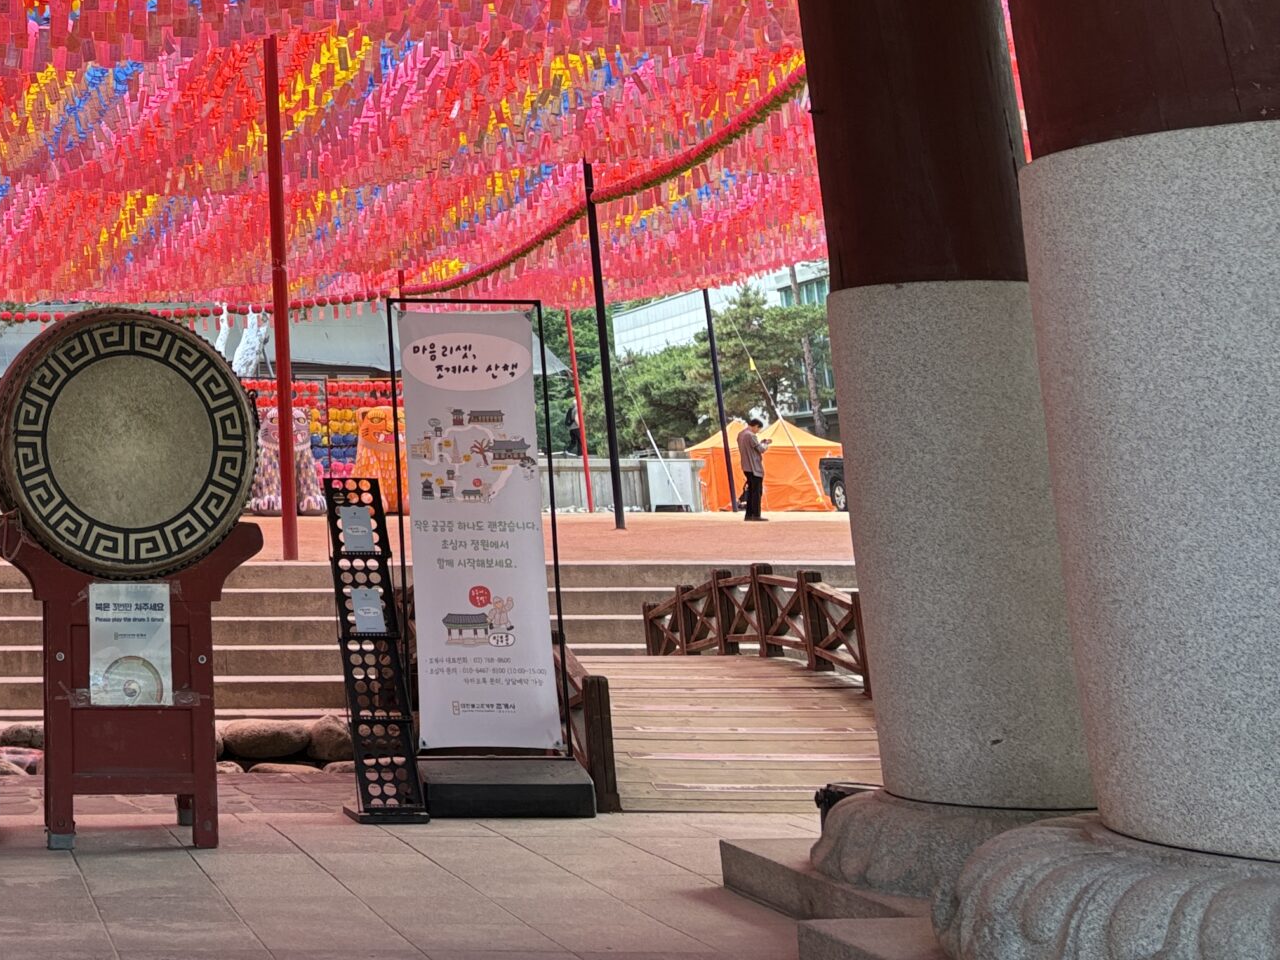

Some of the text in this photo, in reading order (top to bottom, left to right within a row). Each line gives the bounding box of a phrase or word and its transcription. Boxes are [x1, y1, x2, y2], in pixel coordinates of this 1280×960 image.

[412, 342, 437, 362] 마음
[435, 362, 519, 380] 조계사 산책
[414, 519, 429, 532] 작은
[431, 520, 454, 533] 궁금증
[457, 520, 485, 531] 하나도
[441, 539, 509, 551] 초심자 정원에서
[436, 558, 454, 569] 함께
